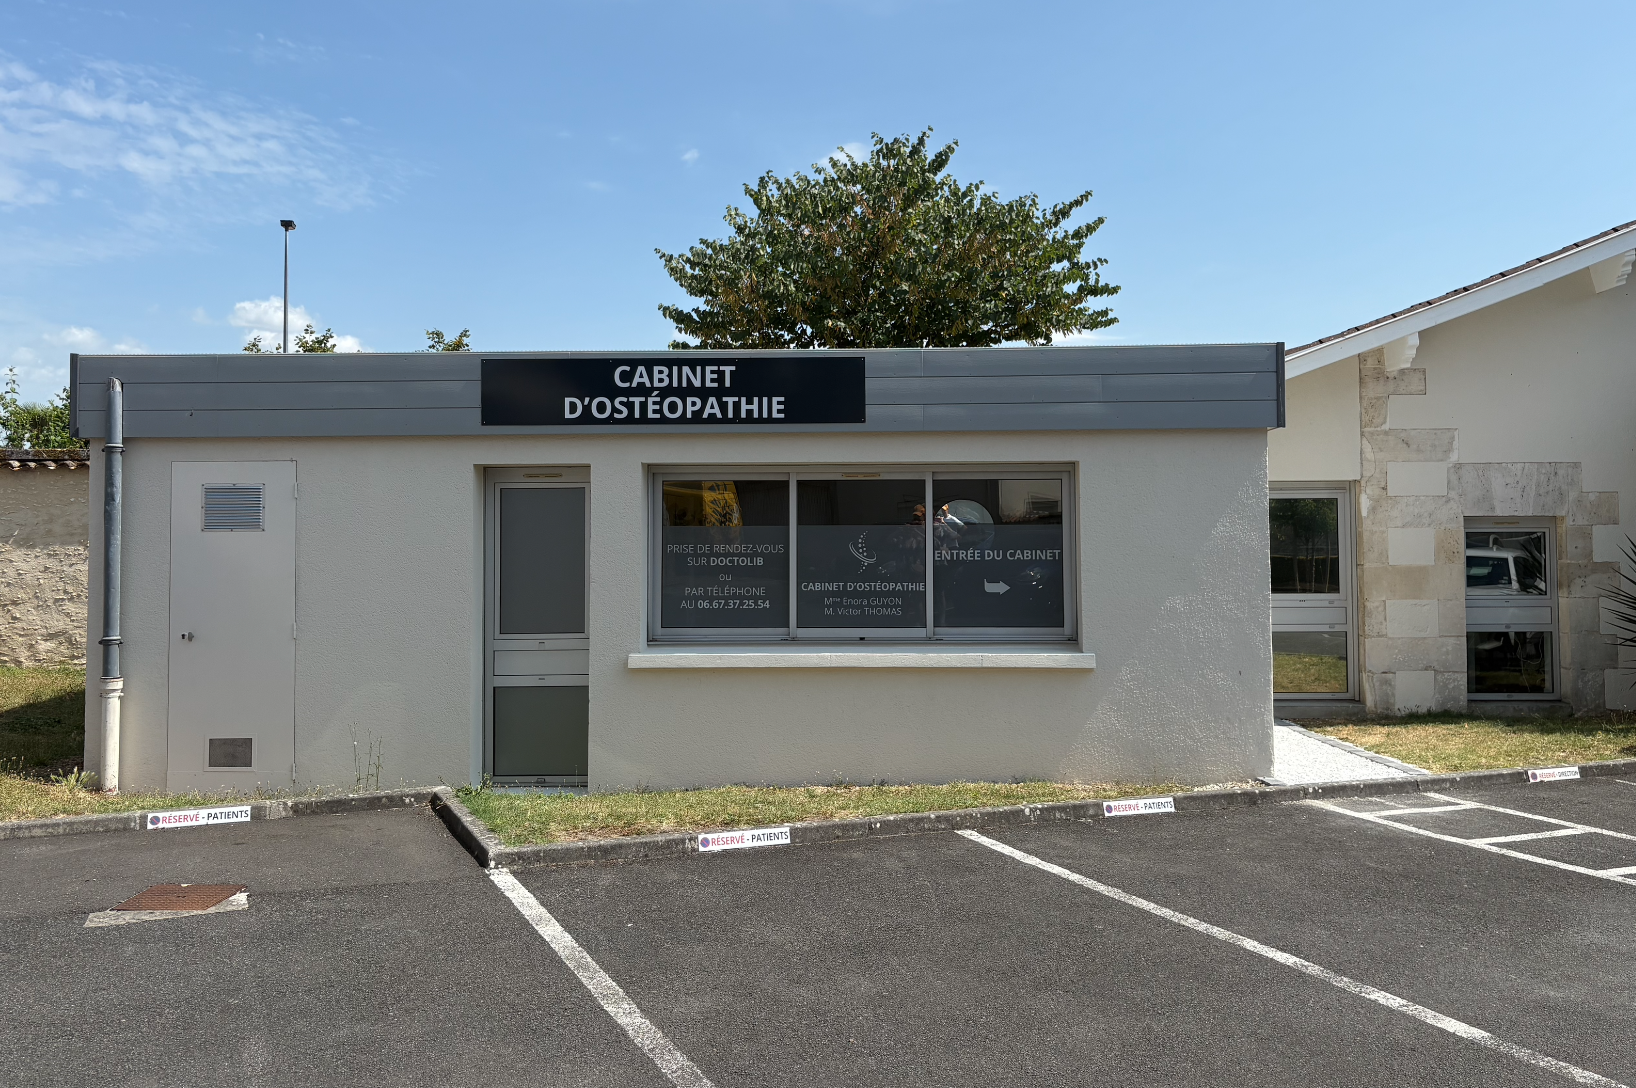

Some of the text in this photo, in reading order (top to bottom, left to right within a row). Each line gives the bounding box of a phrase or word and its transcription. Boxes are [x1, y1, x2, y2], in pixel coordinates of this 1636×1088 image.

[613, 365, 736, 388] CABINET
[667, 544, 785, 554] PRISE DE RENDEZ-VOUS
[934, 548, 1061, 560] ENTRÉE DU CABINET
[687, 557, 764, 566] SUR DOCTOLIB
[684, 585, 766, 596] PAR TÉLÉPHONE
[801, 582, 845, 592] CABINET
[680, 600, 770, 609] AU 06.67.37.25.54
[843, 597, 868, 606] Enora
[869, 597, 902, 606] GUYON
[824, 607, 902, 616] M. Victor THOMAS
[1113, 801, 1140, 813] RÉSERVÉ
[1144, 801, 1173, 811] PATIENTS
[161, 811, 200, 825] RÉSERVÉ
[207, 810, 249, 820] PATIENTS
[711, 833, 745, 847] RÉSERVÉ
[751, 831, 788, 843] PATIENTS
